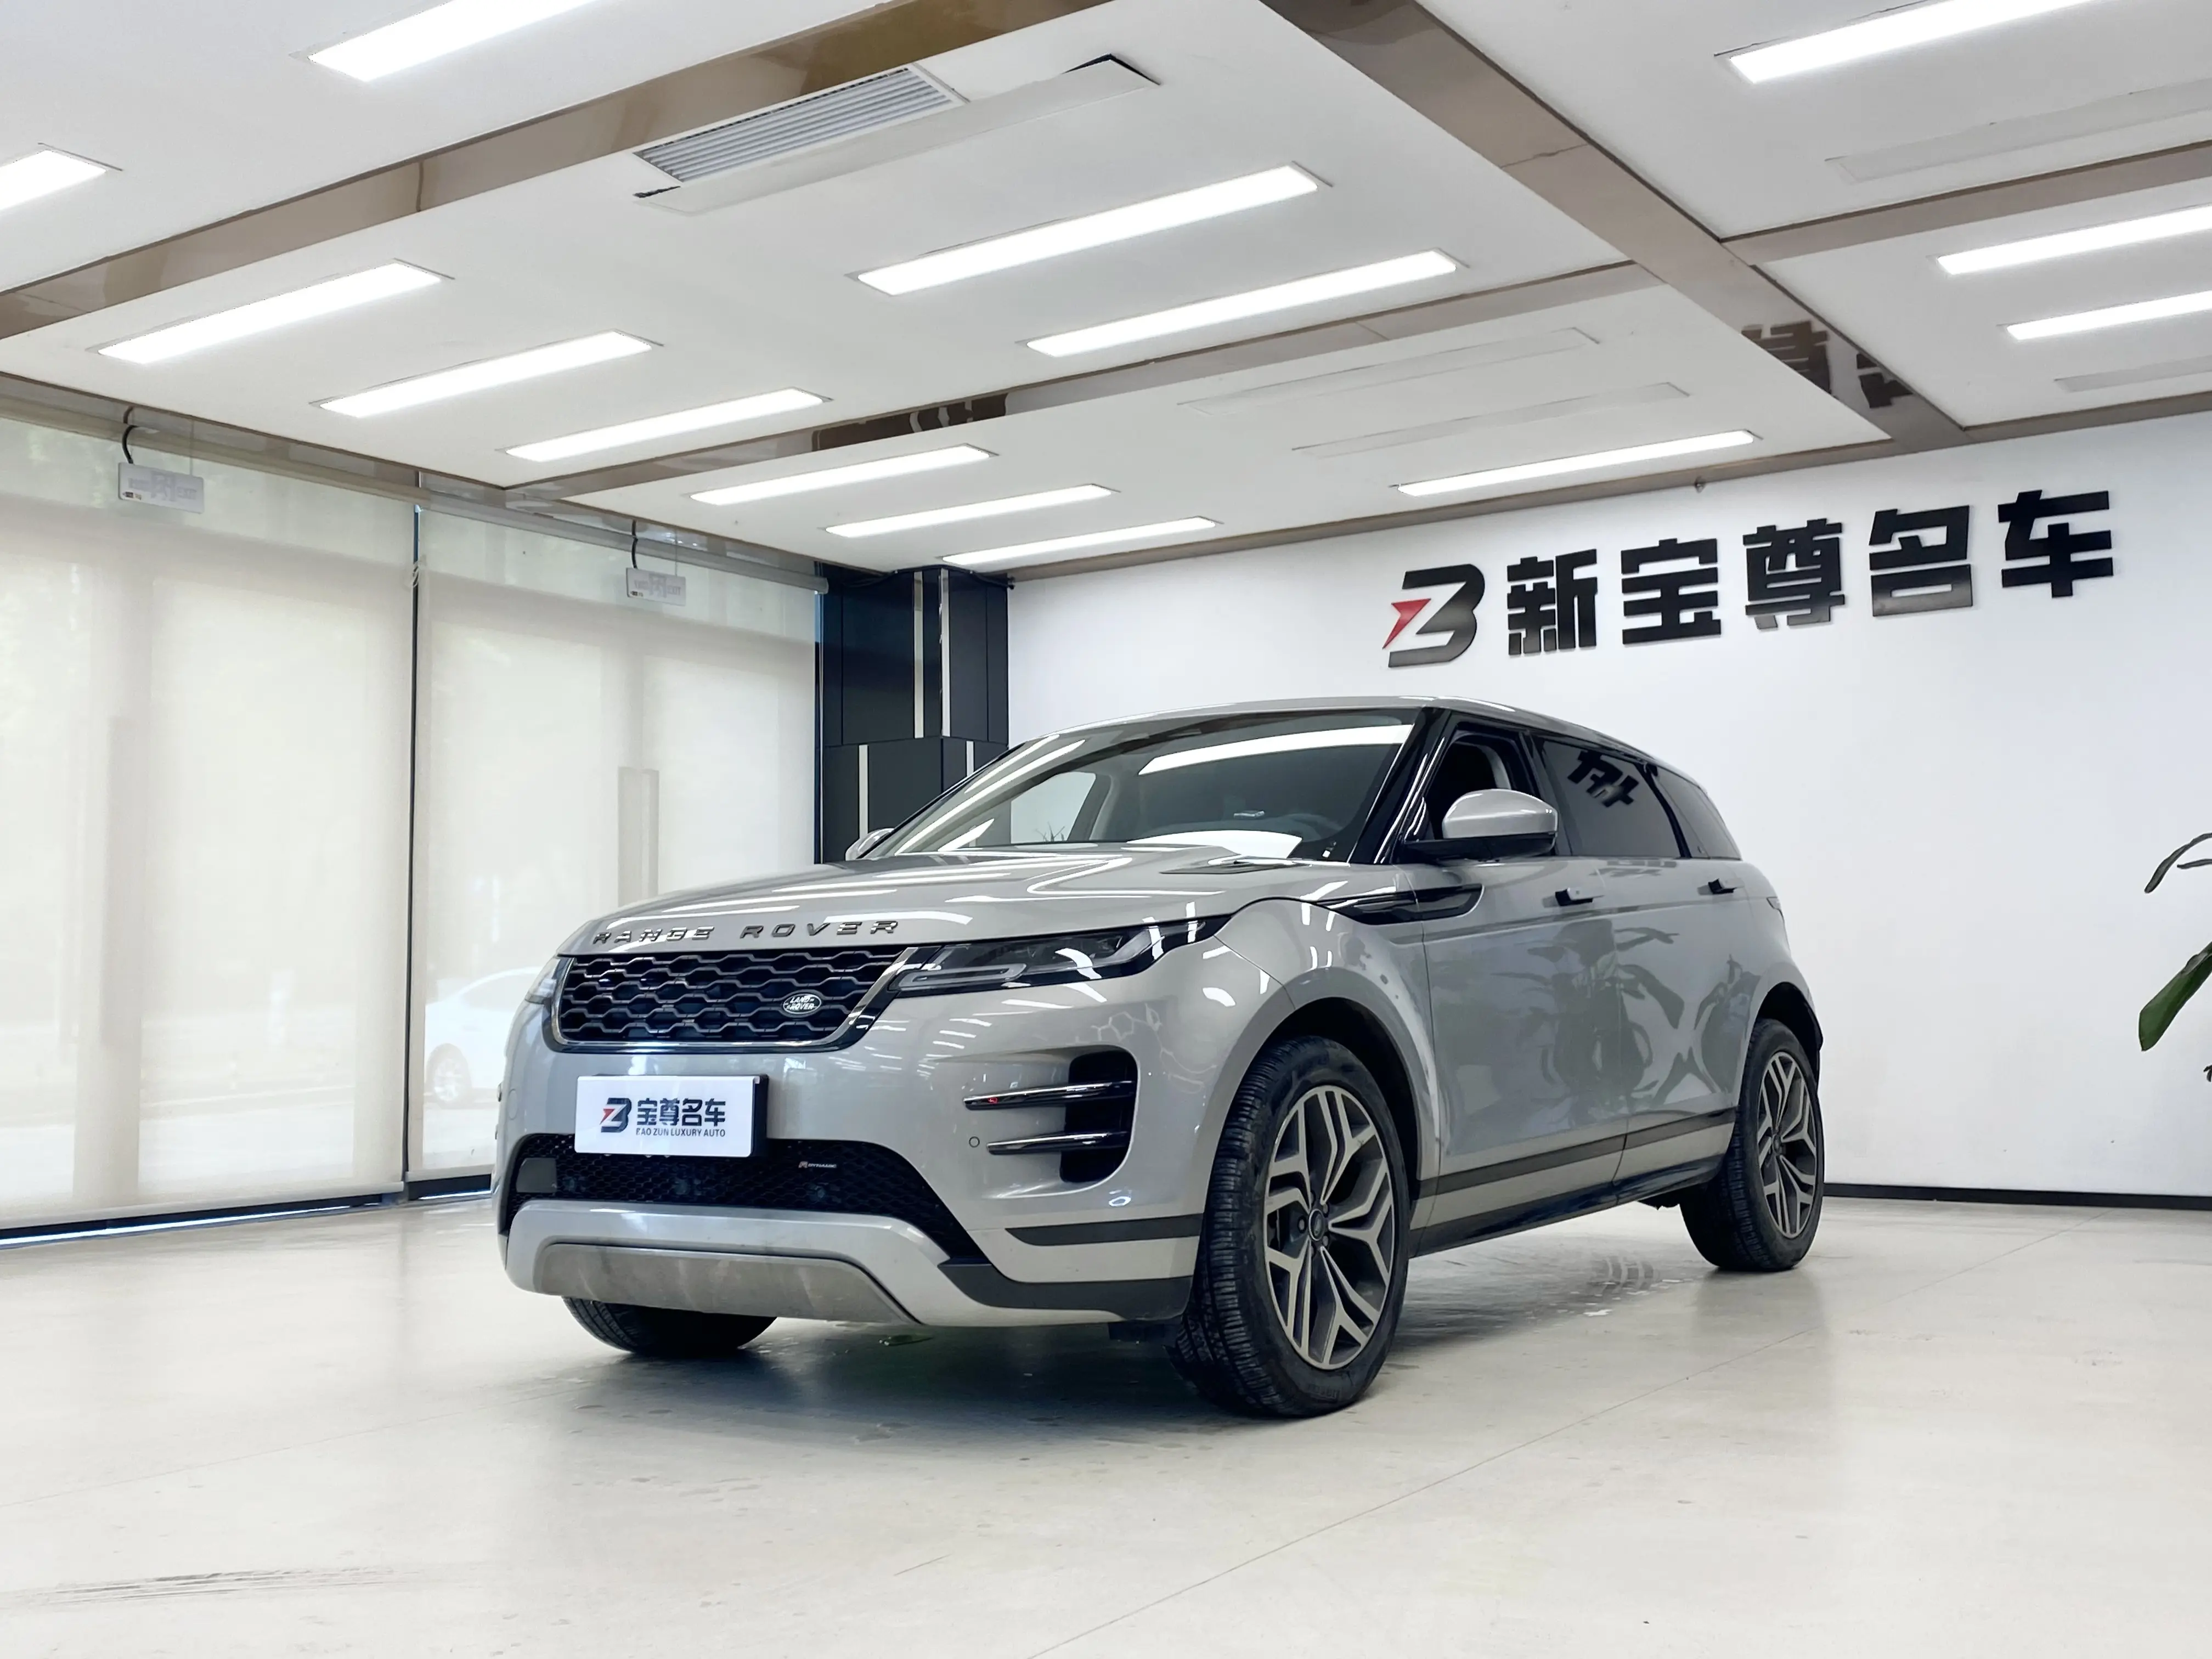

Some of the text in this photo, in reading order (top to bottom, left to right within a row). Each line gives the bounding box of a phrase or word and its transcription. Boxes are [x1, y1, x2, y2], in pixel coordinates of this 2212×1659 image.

[1506, 489, 2114, 656] 新宝尊名车
[592, 920, 899, 945] RANGE ROVER
[636, 1098, 726, 1126] 宝尊名车
[653, 1128, 669, 1137] ZUN
[671, 1128, 702, 1137] LUXURY
[703, 1128, 725, 1137] AUTO
